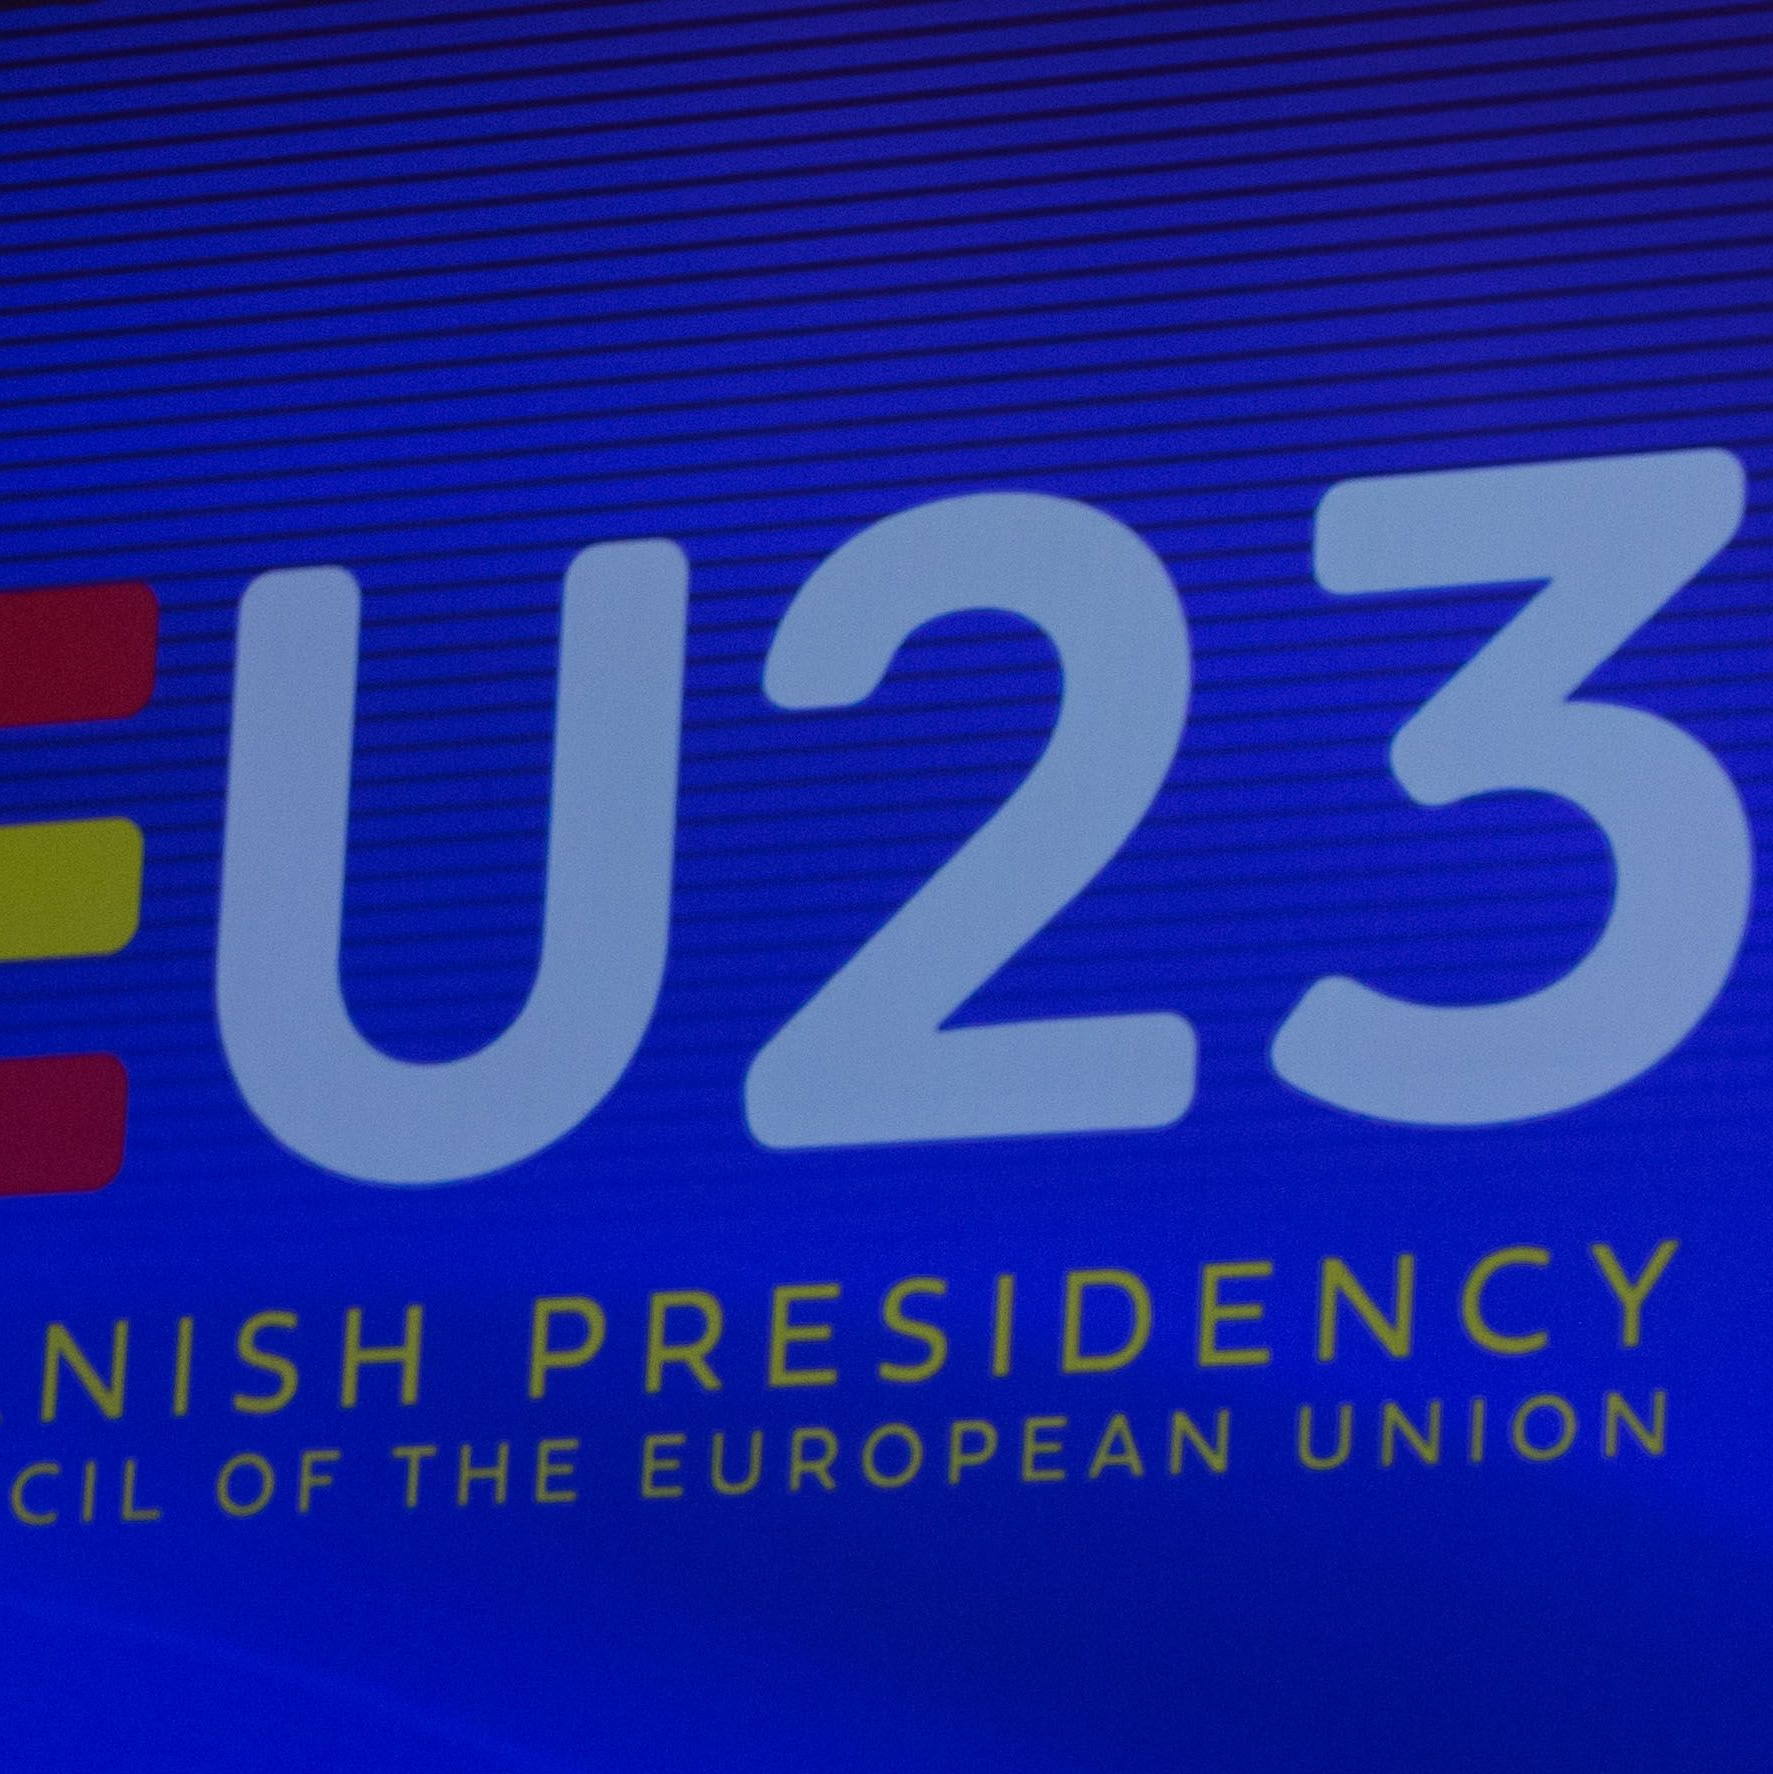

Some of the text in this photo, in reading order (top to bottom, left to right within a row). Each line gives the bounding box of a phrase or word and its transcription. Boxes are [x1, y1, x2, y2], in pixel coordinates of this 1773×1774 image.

[526, 1238, 1680, 1400] PRESIDENCY
[215, 1448, 341, 1517] OF
[392, 1437, 580, 1507] THE
[640, 1409, 1232, 1499] EUROPEAN
[1296, 1389, 1668, 1471] UNION
